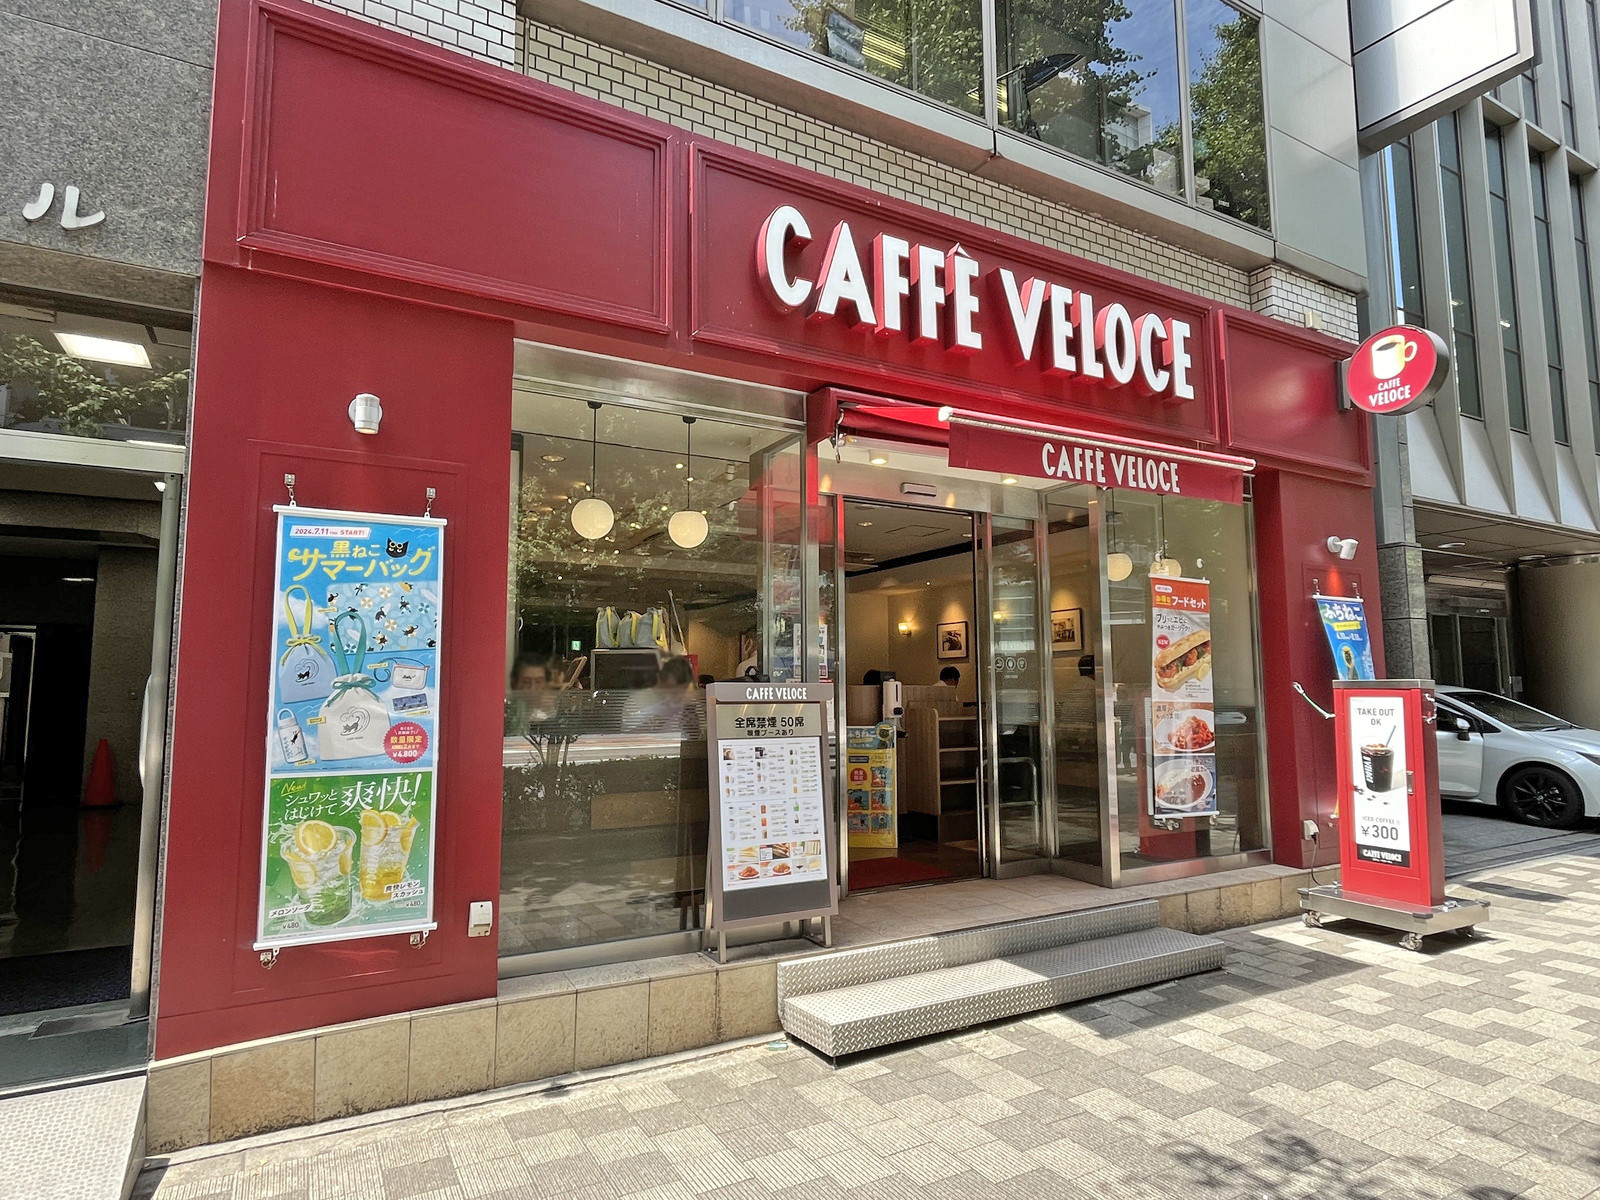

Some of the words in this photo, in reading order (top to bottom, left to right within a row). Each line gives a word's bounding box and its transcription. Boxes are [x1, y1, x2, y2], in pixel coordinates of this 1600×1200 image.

[22, 182, 106, 229] ル
[998, 267, 1195, 400] VELOCE
[1368, 385, 1412, 408] VELOCE
[1042, 442, 1107, 484] CAFFÈ
[1109, 452, 1181, 494] VELOCE
[294, 527, 329, 535] 2024.7.11
[330, 540, 381, 559] 黒ねこ
[288, 546, 436, 581] サマーバッグ
[775, 687, 807, 700] VELOCE
[1357, 707, 1378, 717] TAKE
[1378, 708, 1395, 717] OUT
[734, 716, 778, 729] 全席禁煙
[780, 716, 805, 728] 50席
[1370, 718, 1382, 726] OK
[390, 735, 423, 744] 数量限定
[285, 788, 338, 808] シュワッと
[339, 773, 422, 817] 爽快!
[284, 802, 337, 821] はじけて
[1361, 824, 1399, 841] ¥300
[270, 903, 312, 918] メロンソーダ
